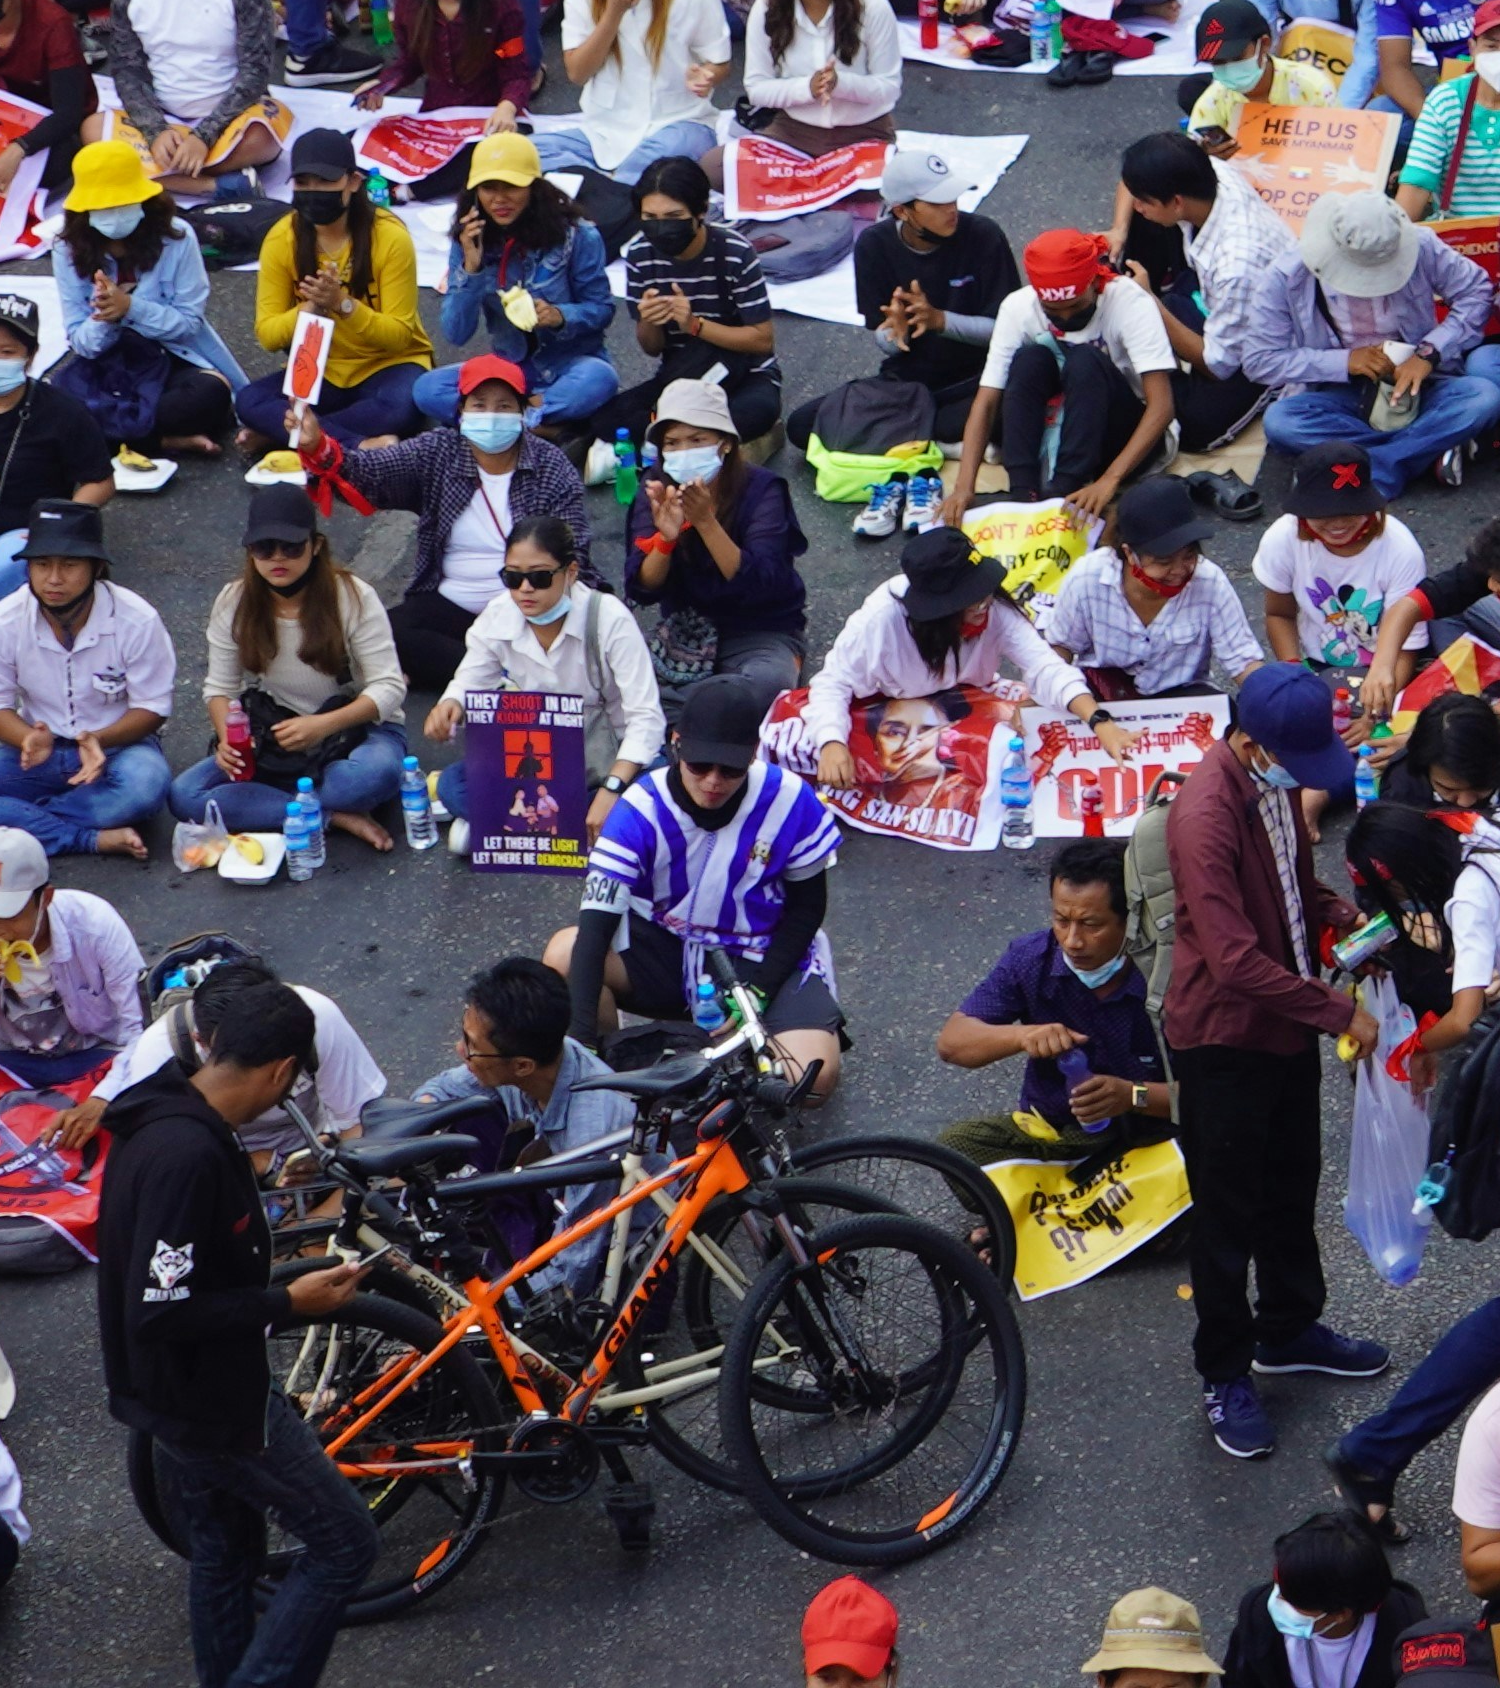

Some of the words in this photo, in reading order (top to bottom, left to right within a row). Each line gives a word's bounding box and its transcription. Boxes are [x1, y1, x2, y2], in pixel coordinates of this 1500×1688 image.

[1263, 117, 1324, 136] HELP
[1328, 120, 1357, 140] US
[1260, 136, 1290, 148] SAVE
[1291, 138, 1354, 153] MYANMAR
[466, 692, 499, 711] THEY
[501, 693, 541, 711] SHOOT
[544, 695, 558, 712] IN
[560, 697, 584, 714] DAY
[465, 710, 494, 725] THEY
[496, 710, 537, 726] KIDNAP
[539, 712, 552, 725] AT
[553, 713, 585, 728] NIGHT
[483, 835, 504, 850] LET
[503, 836, 537, 851] THERE
[537, 837, 551, 851] BE
[551, 838, 579, 852] LIGHT
[472, 851, 491, 864] LET
[492, 852, 522, 866] THERE
[523, 853, 536, 866] BE
[536, 853, 589, 869] DEMOCRACY
[602, 1239, 675, 1361] GIANT
[1405, 1642, 1461, 1664] Supreme
